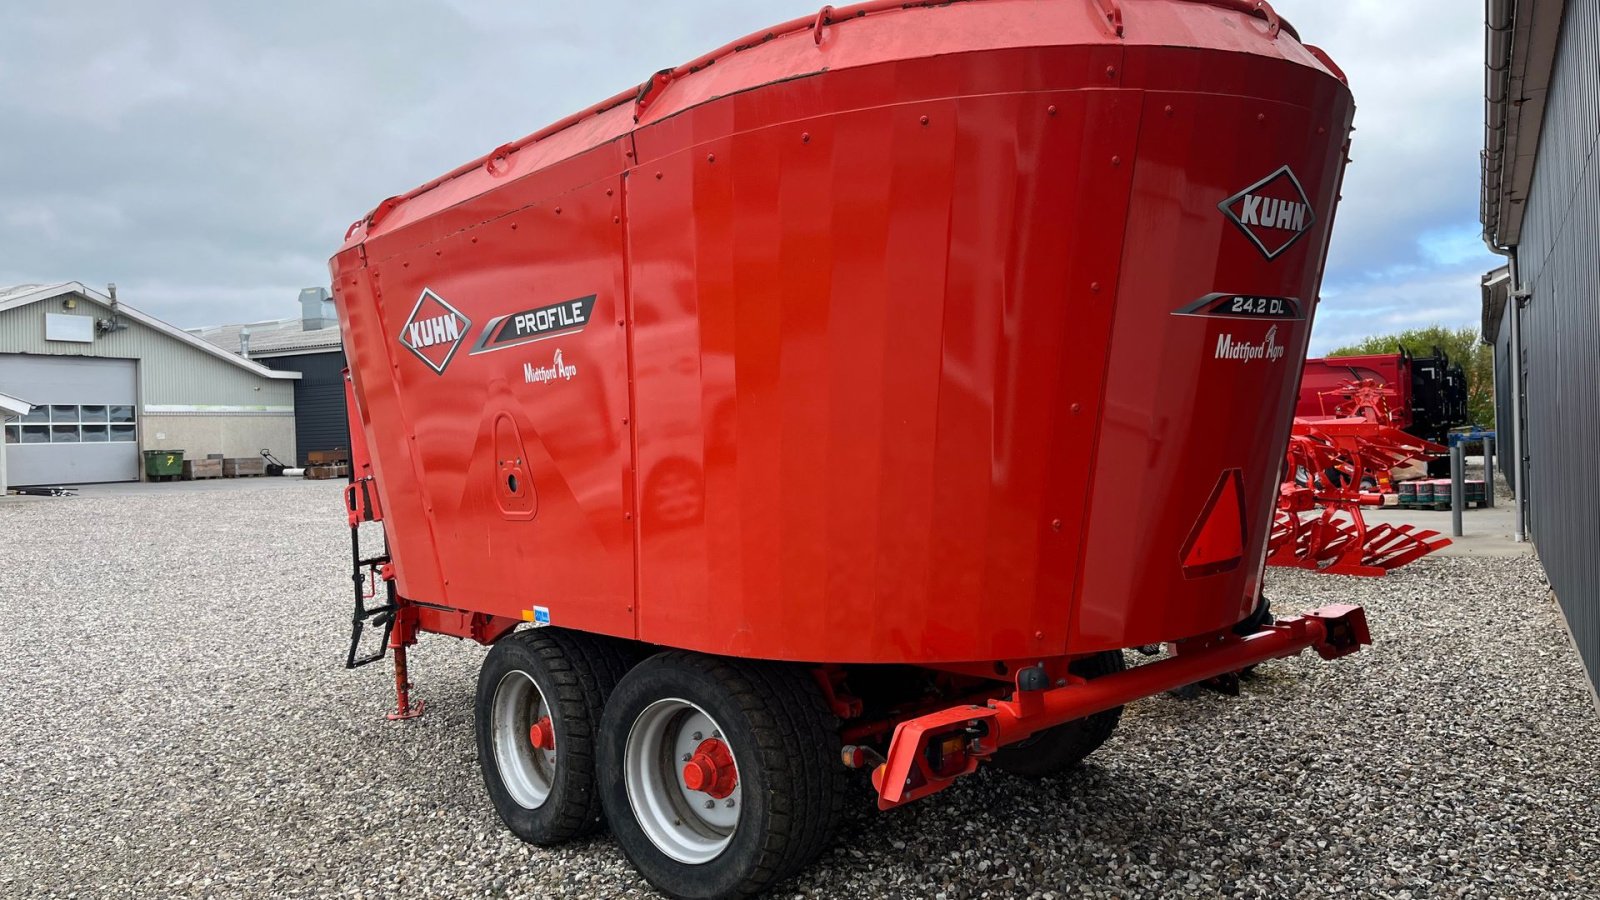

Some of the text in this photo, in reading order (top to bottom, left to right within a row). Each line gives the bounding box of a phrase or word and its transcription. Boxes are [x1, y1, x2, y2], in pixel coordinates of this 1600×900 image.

[1240, 194, 1306, 232] KUHN
[514, 301, 585, 335] PROFILE
[1231, 297, 1284, 314] 24.2 DL
[409, 313, 459, 349] KUHN
[1214, 327, 1284, 363] Midtfjord Agro
[523, 350, 576, 383] Midtfjord Agro
[166, 455, 175, 466] 7
